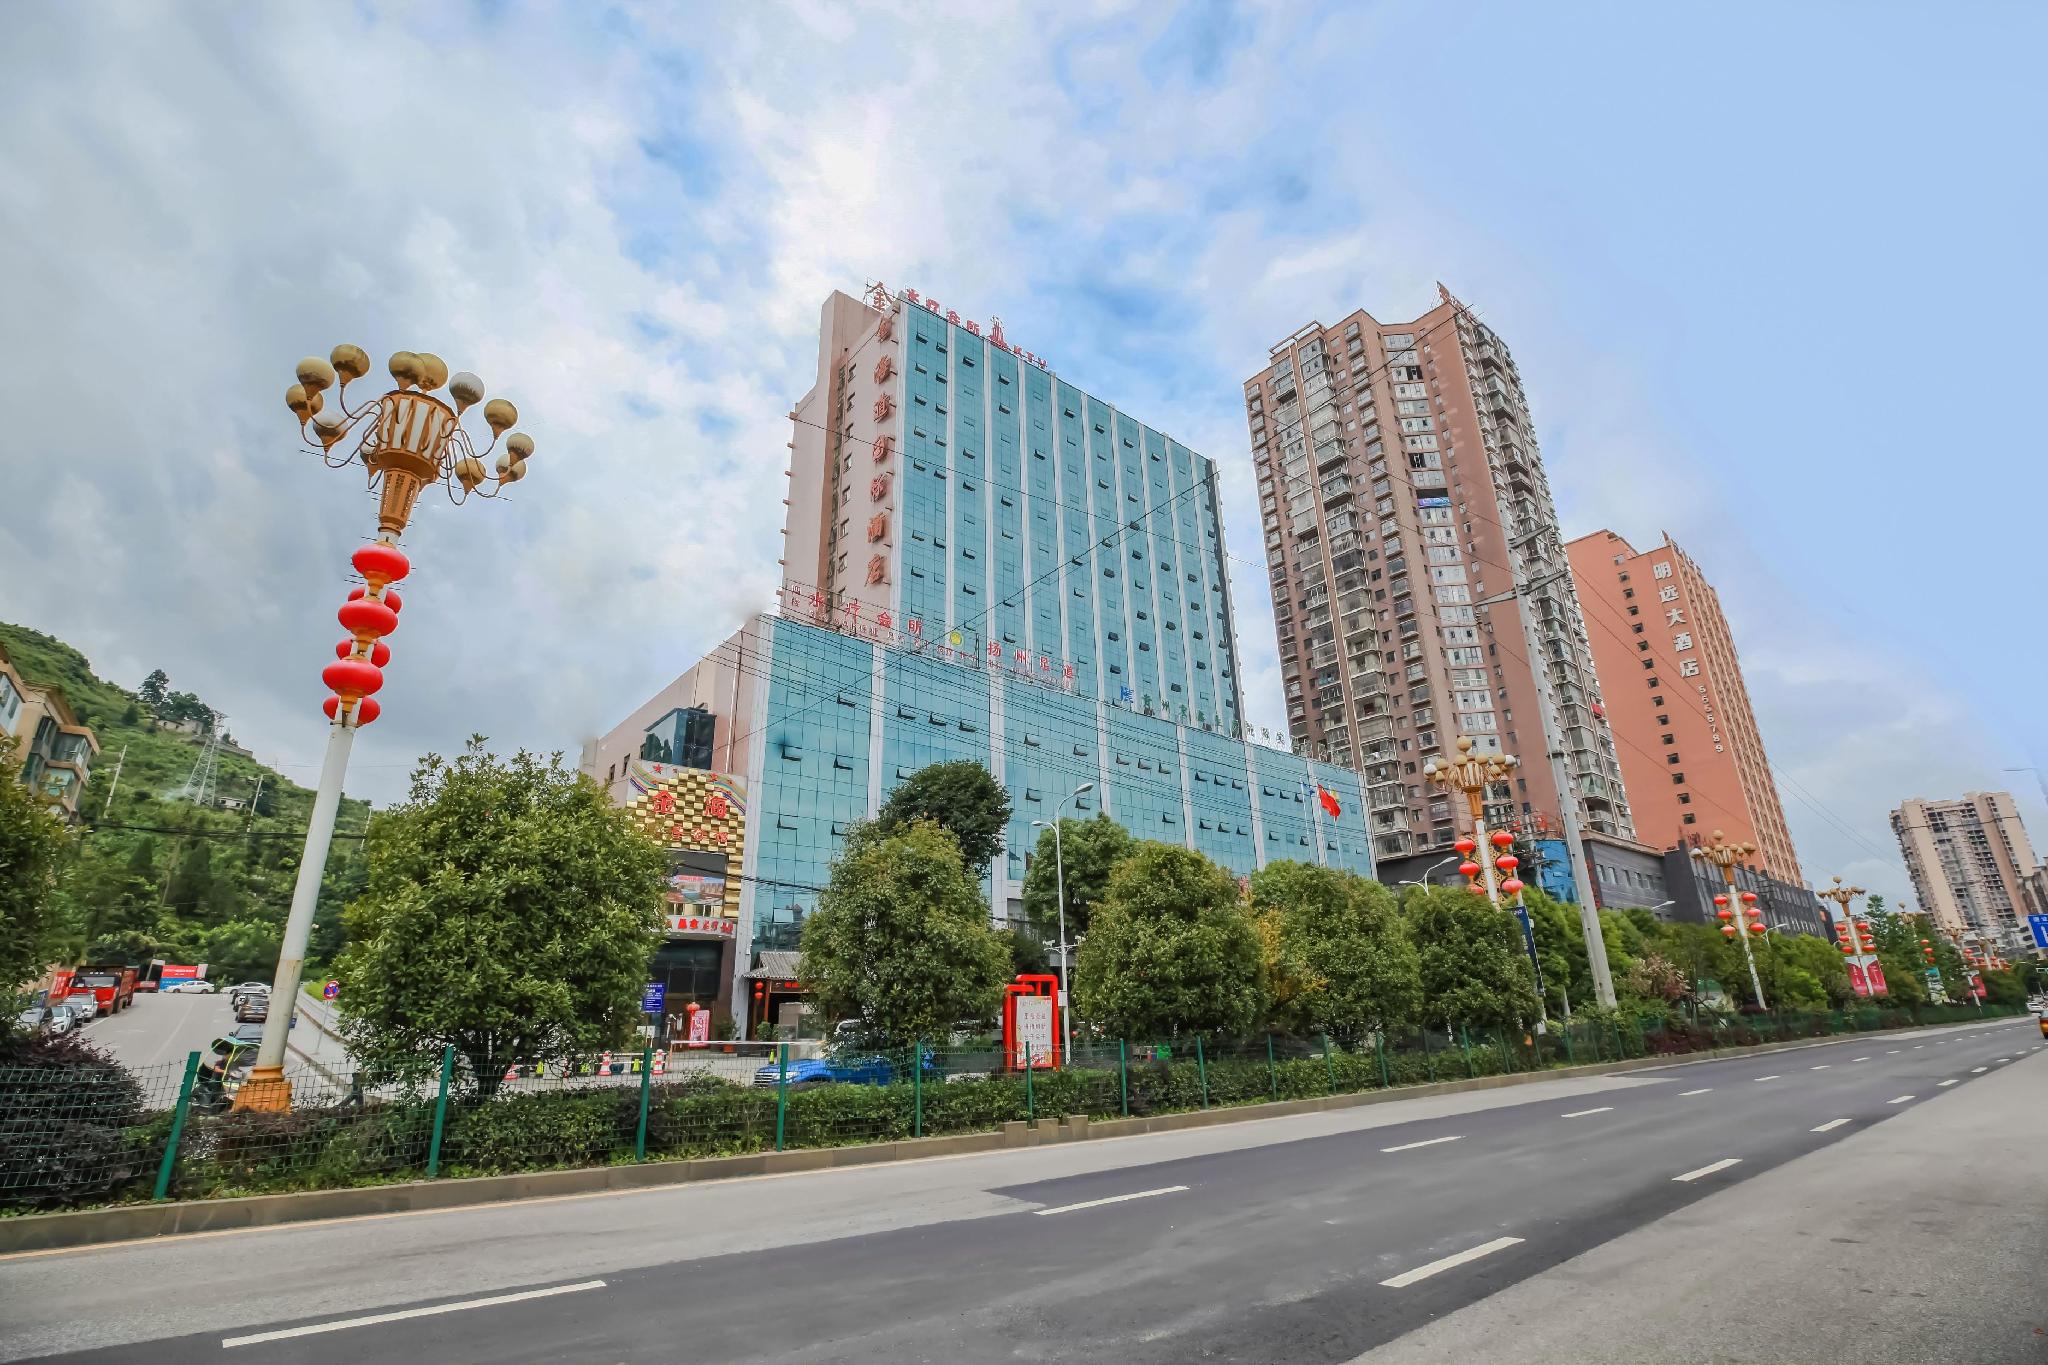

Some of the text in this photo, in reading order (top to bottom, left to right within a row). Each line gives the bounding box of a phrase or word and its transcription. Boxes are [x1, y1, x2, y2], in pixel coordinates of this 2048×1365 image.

[809, 592, 923, 639] 水疗会所
[1653, 561, 1700, 678] 明远大酒店
[987, 641, 1073, 679] 扬州足道
